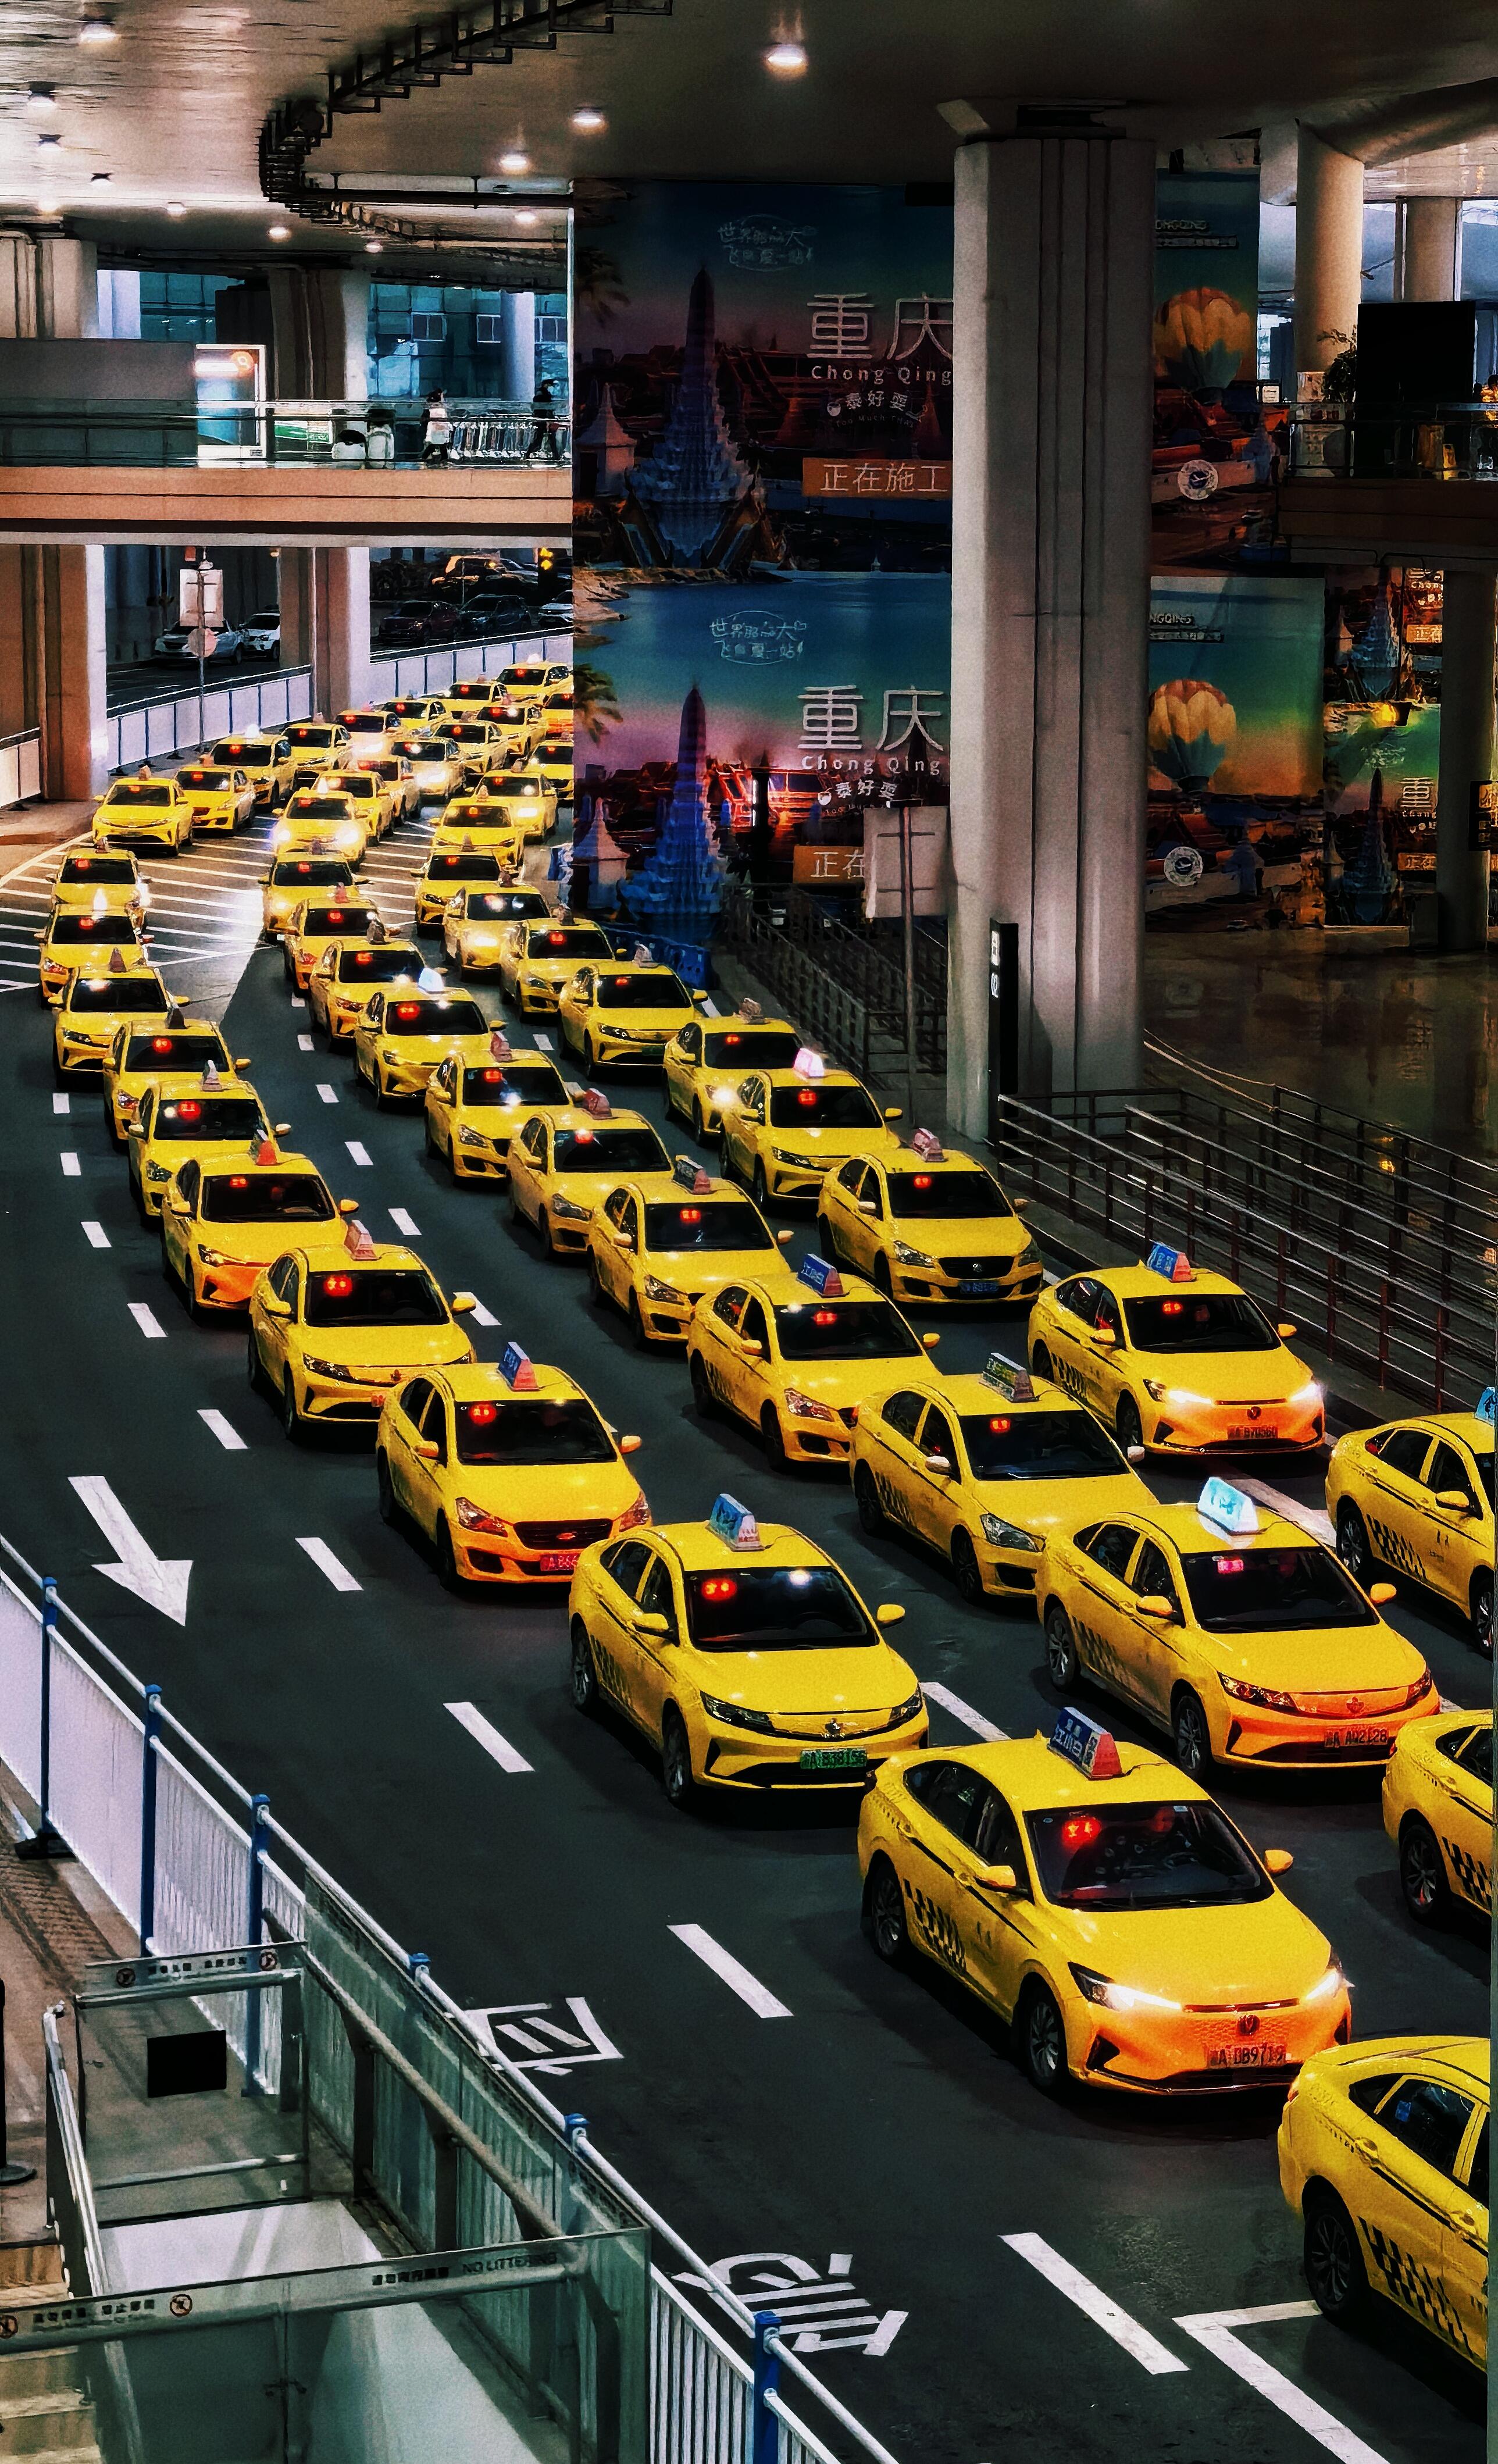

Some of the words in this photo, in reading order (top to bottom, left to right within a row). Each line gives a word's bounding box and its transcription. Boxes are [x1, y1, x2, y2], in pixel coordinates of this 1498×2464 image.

[807, 293, 953, 360] 重庆
[811, 365, 883, 385] Chong
[898, 366, 952, 386] Qing
[820, 463, 948, 493] 正在施工
[797, 684, 944, 751] 重庆
[801, 755, 874, 775] Chong
[888, 757, 941, 775] Qing
